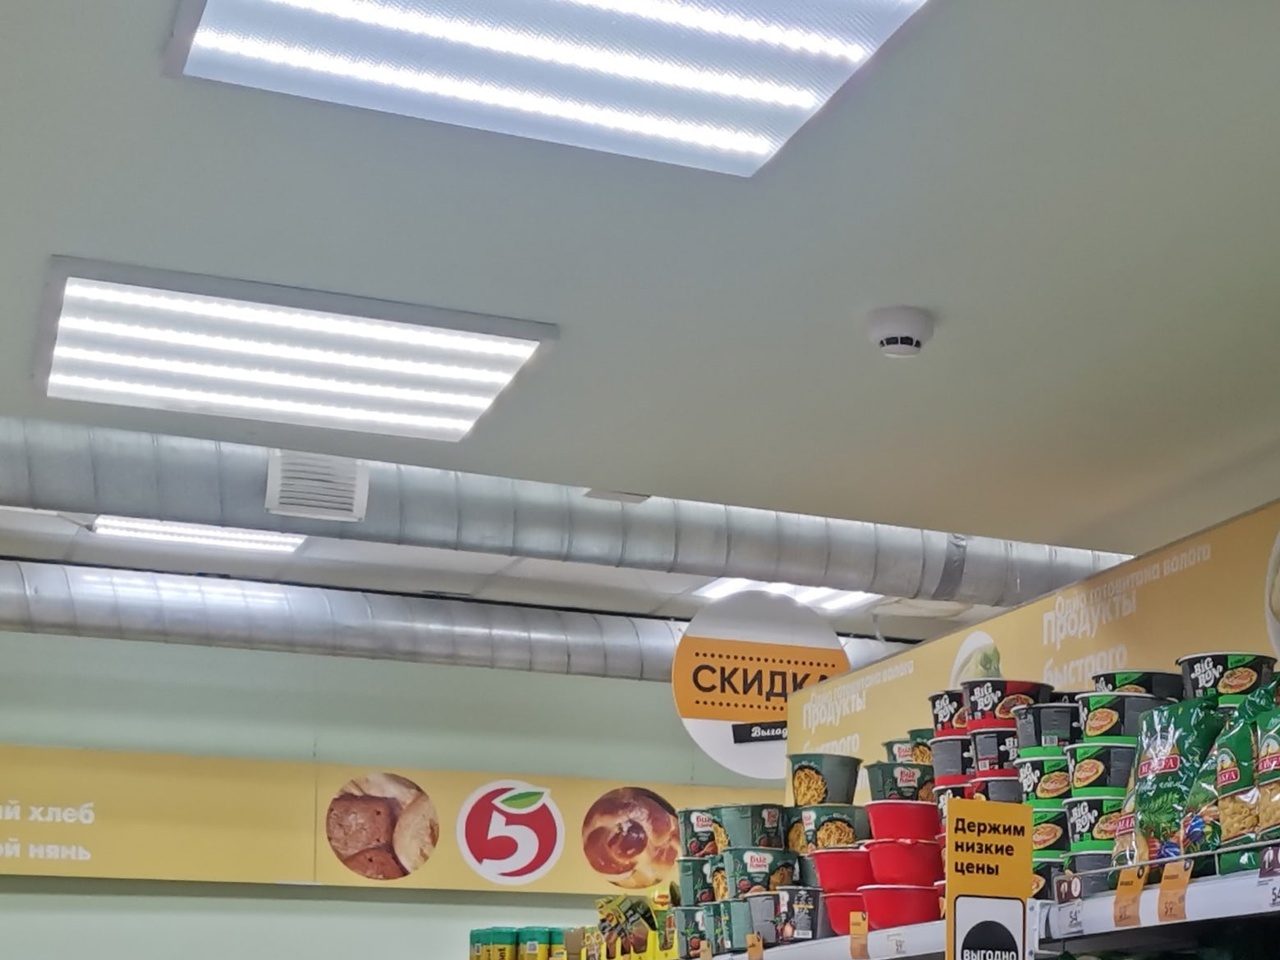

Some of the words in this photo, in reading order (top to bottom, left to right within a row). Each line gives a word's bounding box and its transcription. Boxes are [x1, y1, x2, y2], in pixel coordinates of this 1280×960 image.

[1042, 589, 1137, 651] Продукты
[1043, 644, 1127, 689] быстрого
[692, 664, 829, 702] СКИДК
[802, 690, 866, 733] Продукты
[28, 802, 95, 824] хлеб
[954, 817, 1025, 838] Держим
[954, 840, 1014, 858] низкие
[954, 861, 999, 876] цены
